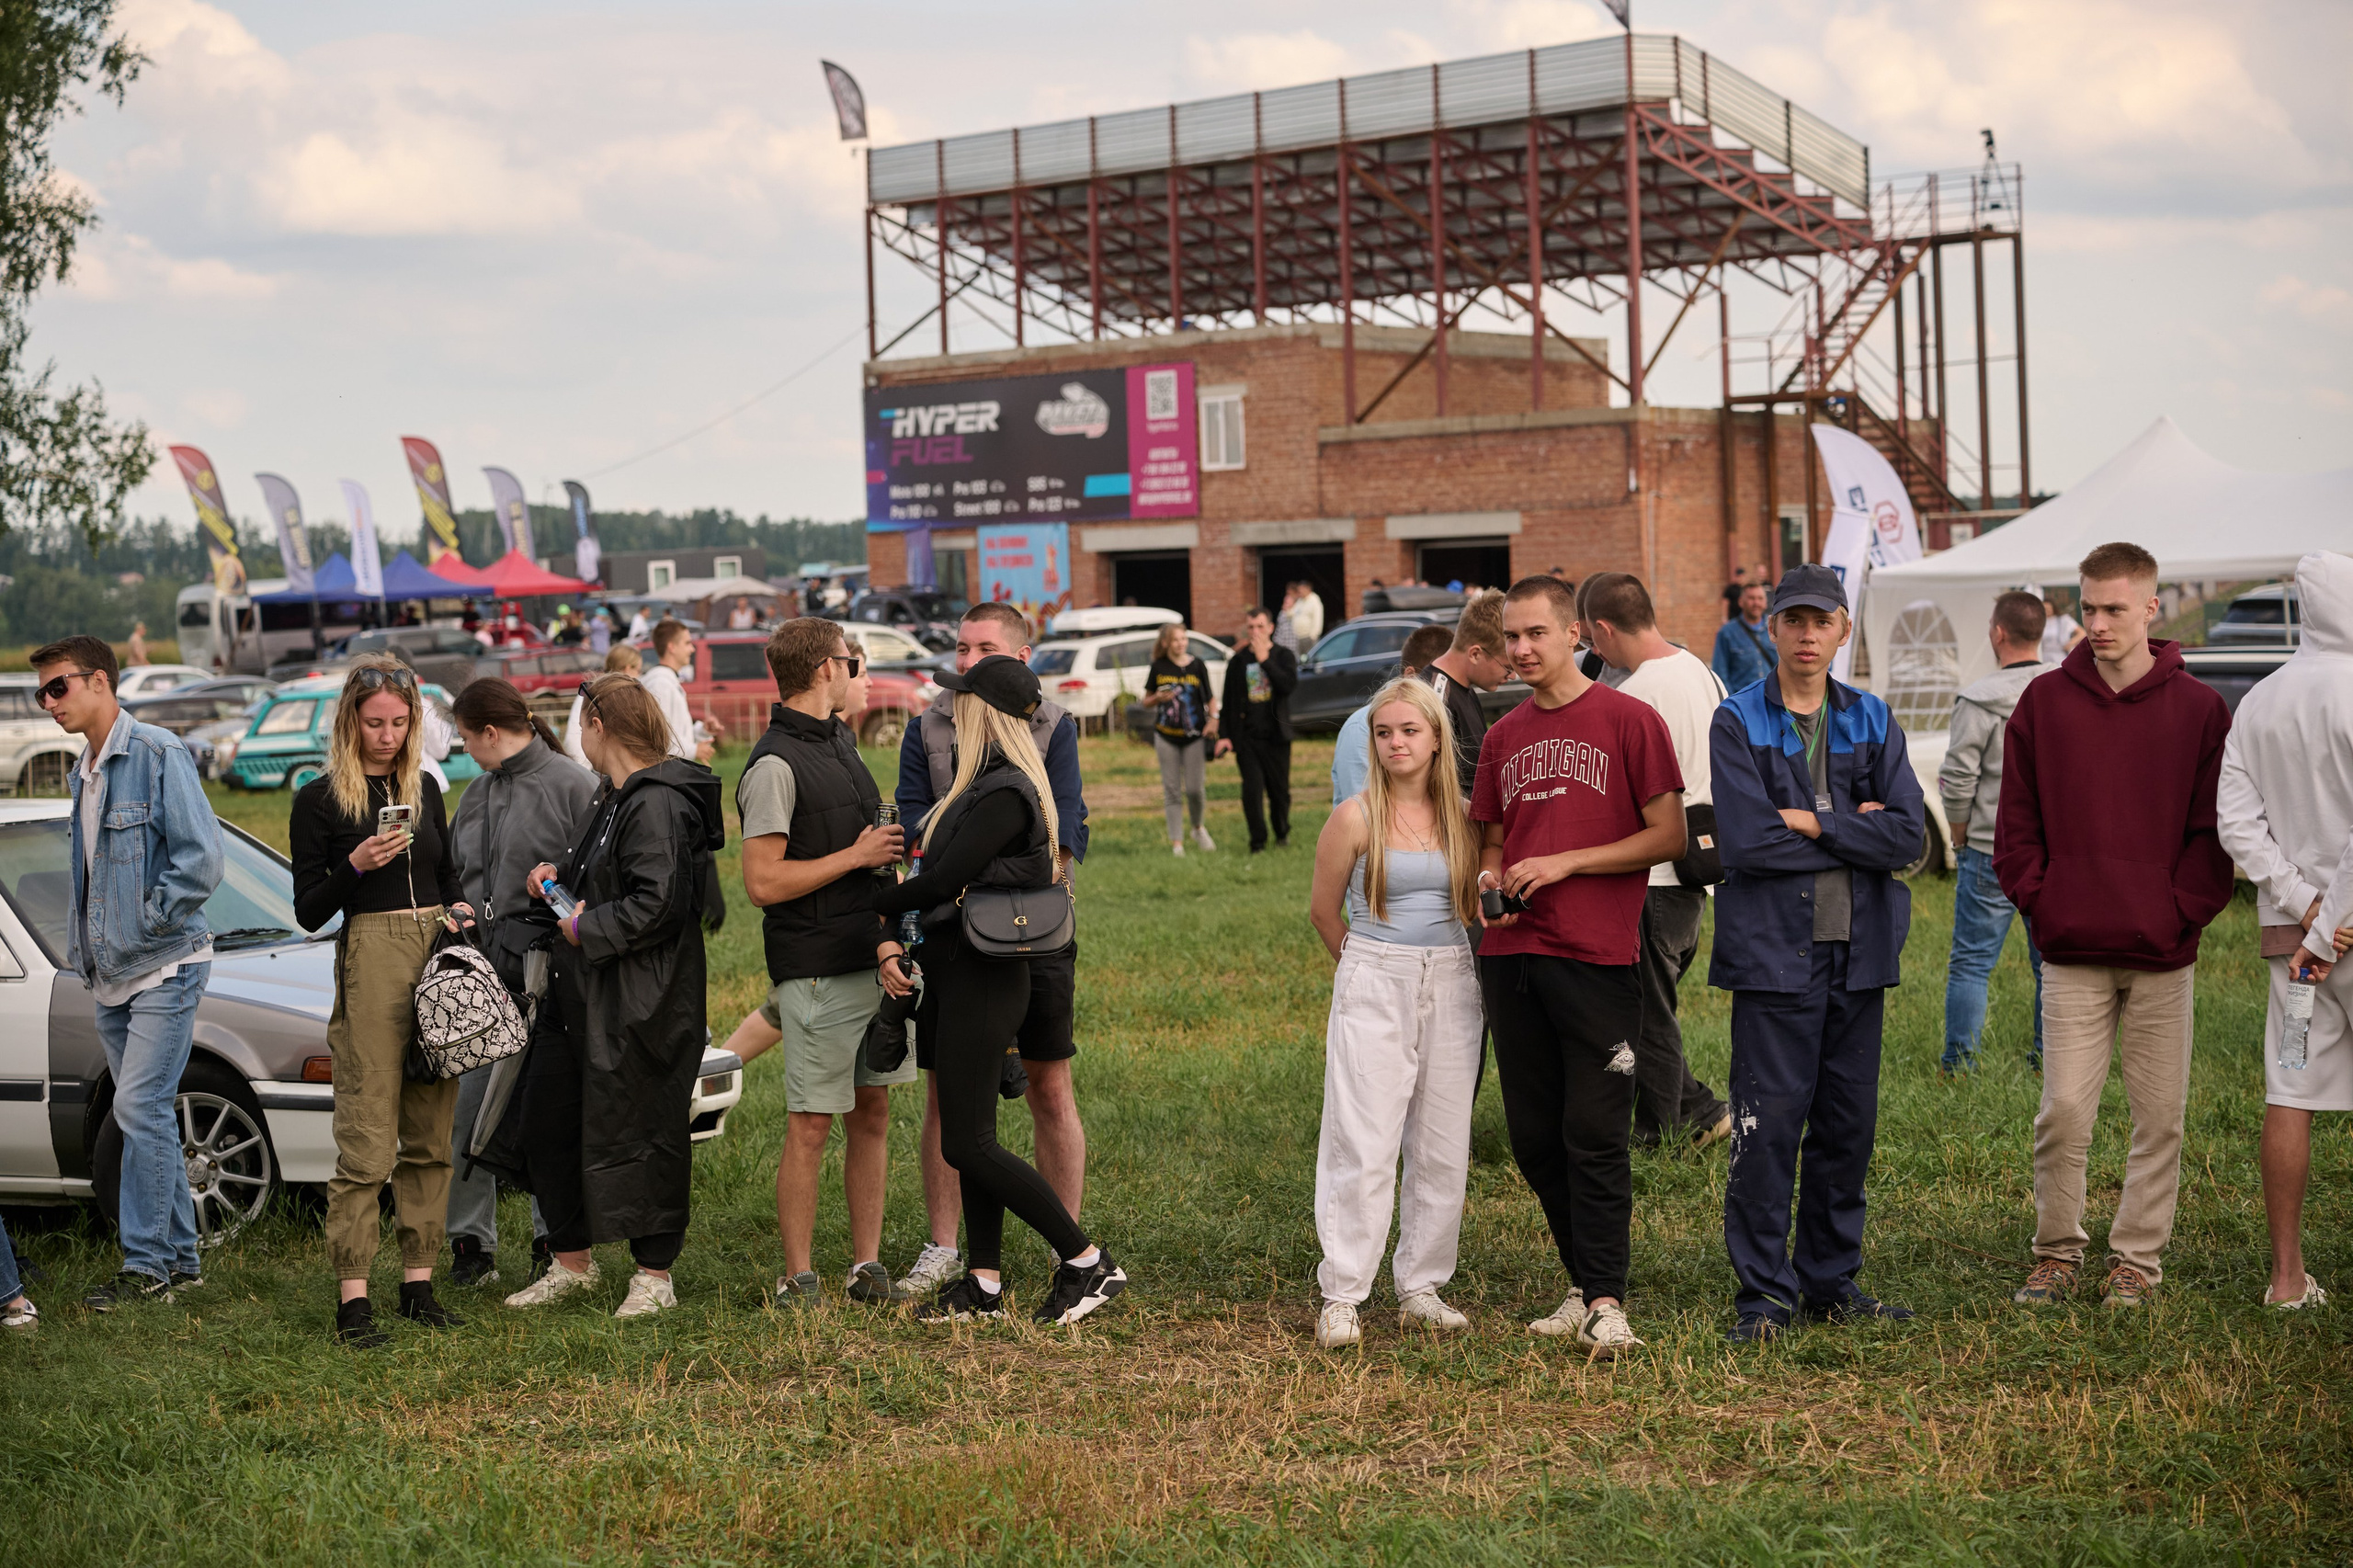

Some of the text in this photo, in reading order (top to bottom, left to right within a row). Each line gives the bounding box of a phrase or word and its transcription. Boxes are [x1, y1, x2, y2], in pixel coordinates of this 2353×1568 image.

[892, 400, 1001, 438] HYPER
[889, 436, 974, 467] FUEL
[1500, 738, 1609, 812] MICHIGAN
[1521, 790, 1549, 801] COLLEGE
[793, 1270, 814, 1279] LACOSTE
